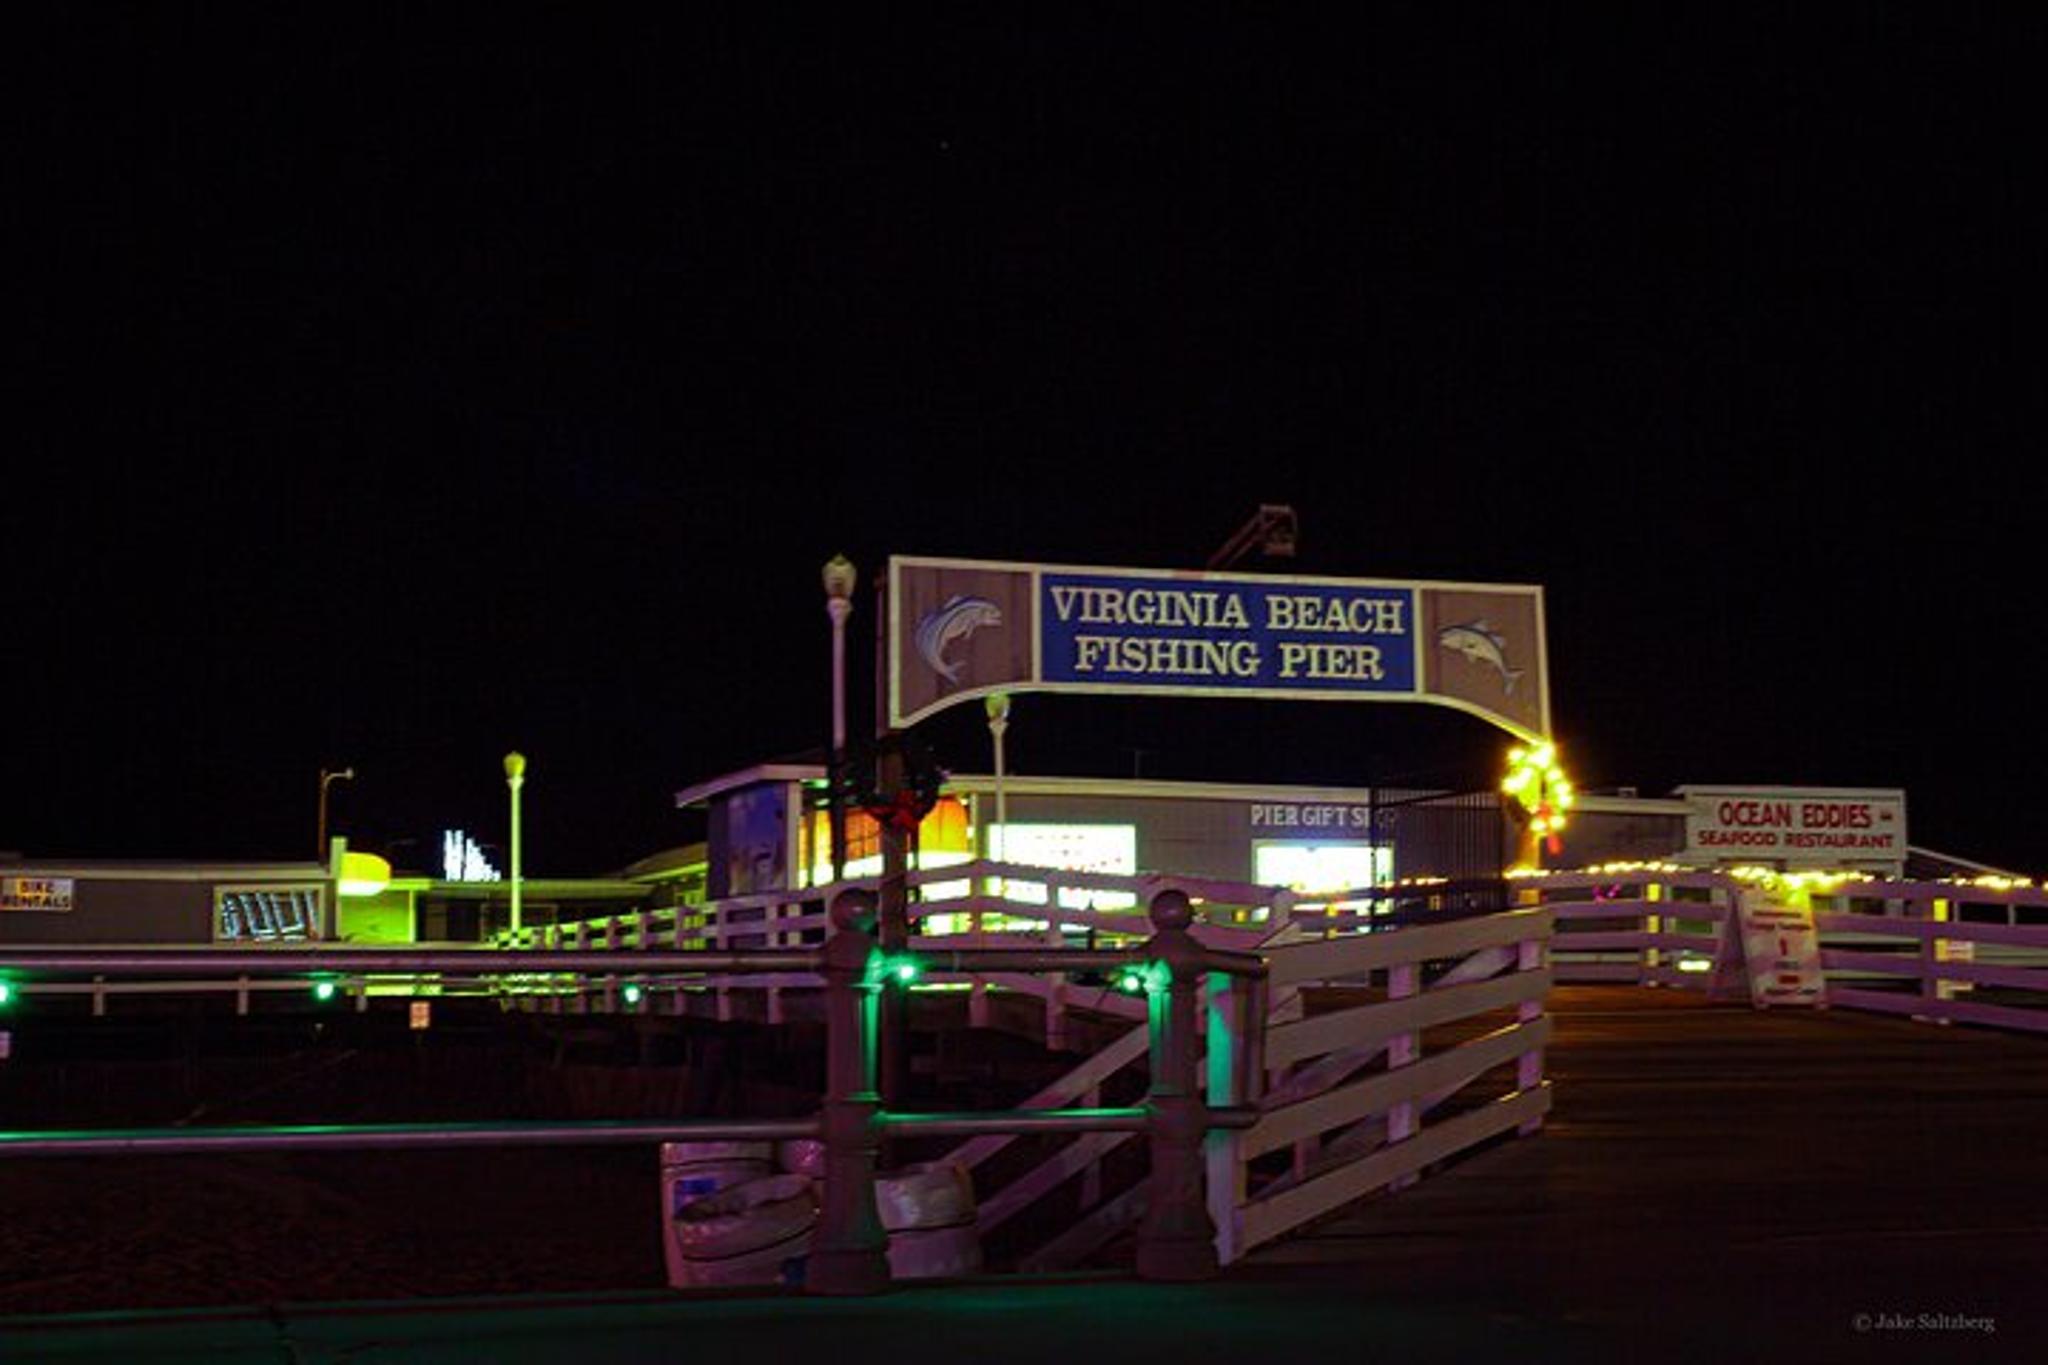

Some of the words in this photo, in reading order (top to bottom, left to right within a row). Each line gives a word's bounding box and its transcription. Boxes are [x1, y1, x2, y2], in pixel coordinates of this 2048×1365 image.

[1050, 585, 1250, 629] VIRGINIA
[1265, 593, 1405, 635] BEACH
[1074, 635, 1261, 677] FISHING
[1278, 642, 1385, 681] PIER
[1250, 804, 1299, 826] PIER
[1302, 805, 1349, 827] GIFT
[1718, 801, 1792, 827] OCEAN
[1802, 803, 1873, 828] EDDIES
[1698, 829, 1778, 847] SEAFOOD
[1784, 832, 1894, 849] RESTAURANT
